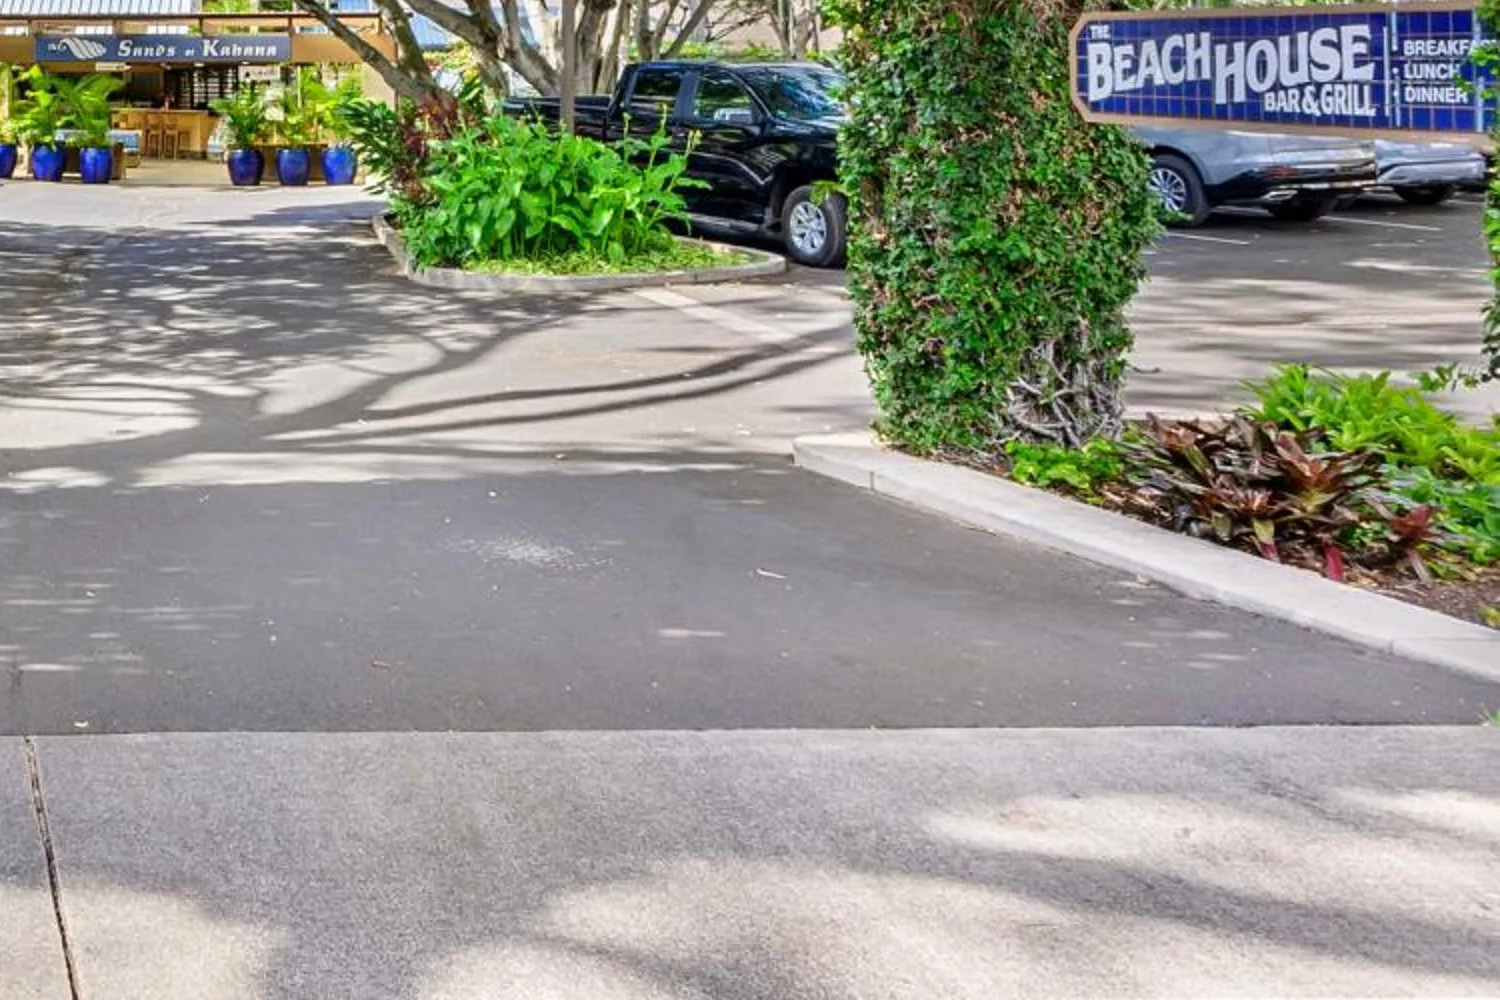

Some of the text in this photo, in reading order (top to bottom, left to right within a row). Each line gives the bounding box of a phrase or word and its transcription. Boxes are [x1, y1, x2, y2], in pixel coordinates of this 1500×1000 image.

[1088, 24, 1375, 104] BEACH HOUSE
[1403, 63, 1461, 79] LUNCH
[1404, 86, 1468, 104] DINNER
